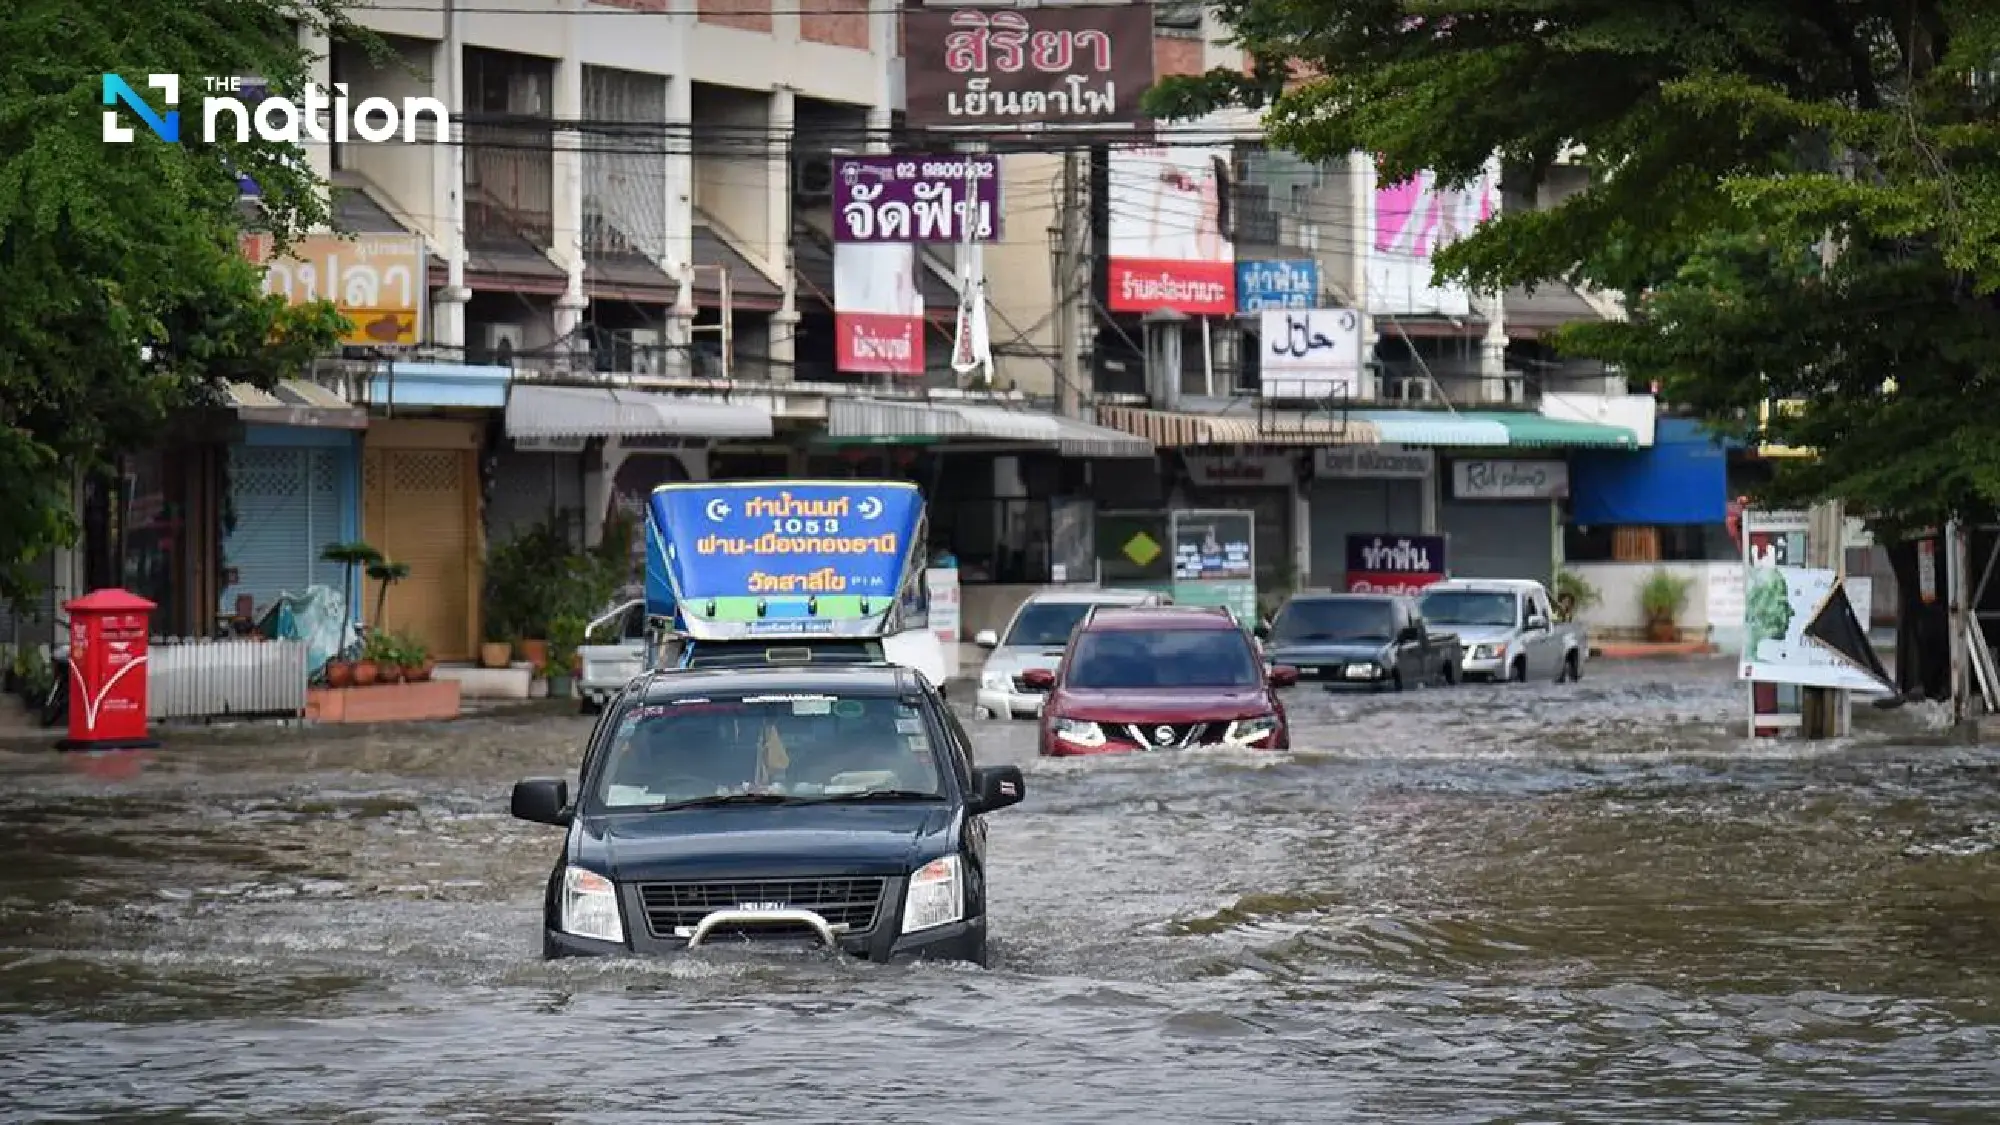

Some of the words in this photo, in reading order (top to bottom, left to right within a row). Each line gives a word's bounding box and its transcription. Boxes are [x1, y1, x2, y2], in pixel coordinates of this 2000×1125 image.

[945, 9, 1112, 73] สิริยา
[948, 74, 1116, 116] เย็นตาโฟ
[843, 181, 992, 238] จัดฟัน
[773, 518, 840, 535] 1053
